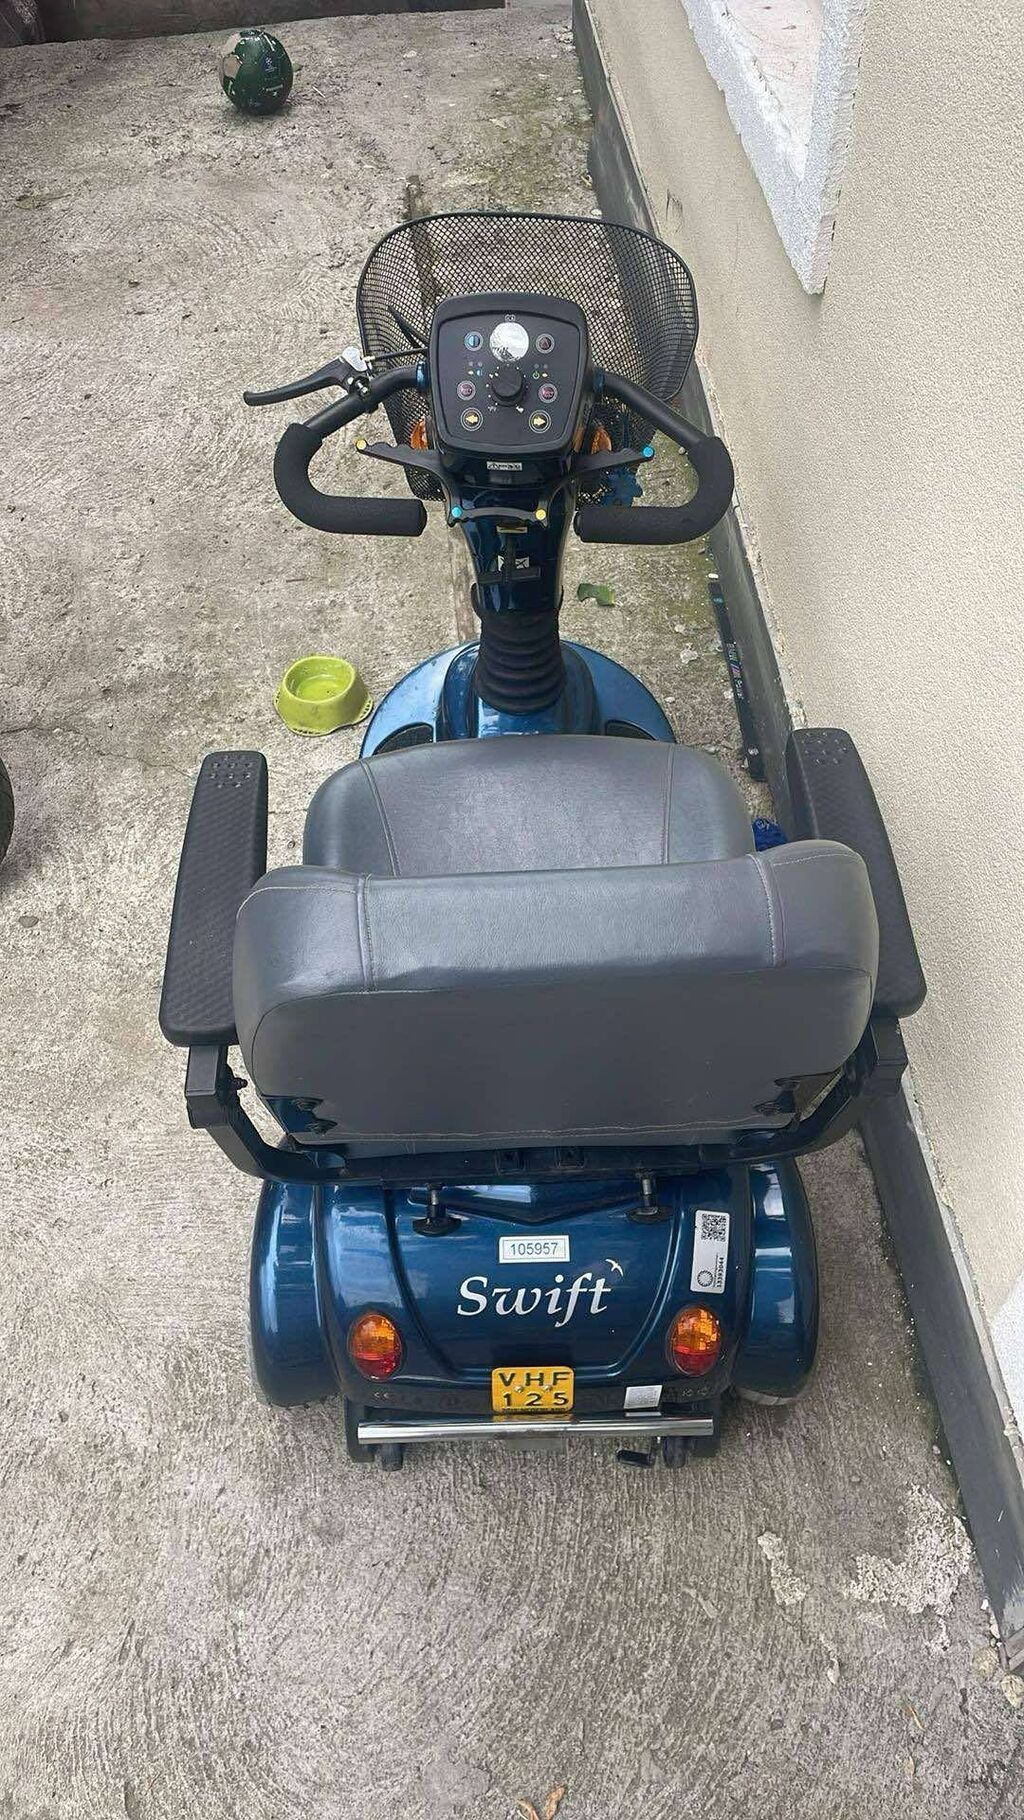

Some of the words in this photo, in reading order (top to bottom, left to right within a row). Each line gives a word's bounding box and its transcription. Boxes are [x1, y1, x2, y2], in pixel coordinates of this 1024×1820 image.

[510, 1242, 559, 1256] 105957
[457, 1272, 612, 1328] Swift
[498, 1371, 571, 1387] VHF
[502, 1392, 570, 1406] 125
